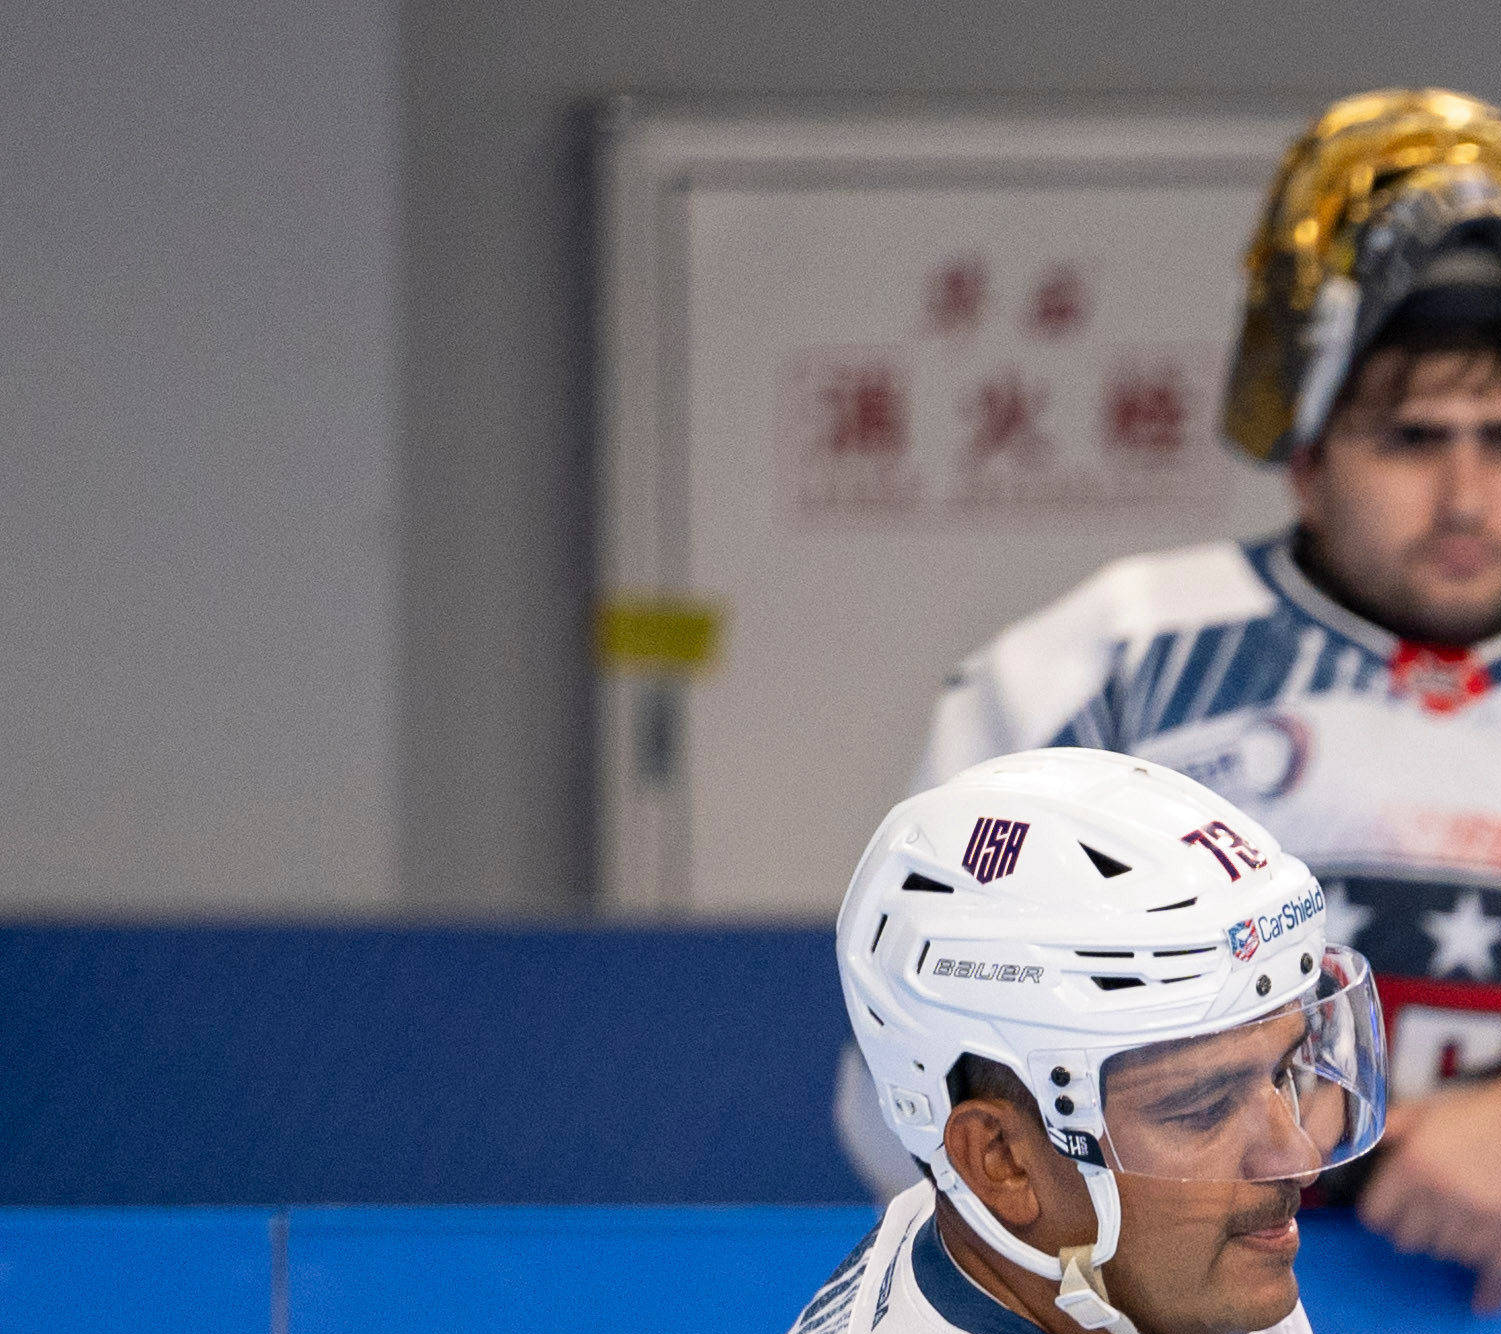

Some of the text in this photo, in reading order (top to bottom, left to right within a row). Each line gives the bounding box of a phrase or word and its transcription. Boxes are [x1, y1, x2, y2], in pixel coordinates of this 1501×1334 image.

[961, 816, 1031, 885] USA
[1257, 886, 1325, 943] CarShield
[932, 957, 1045, 985] BAUER
